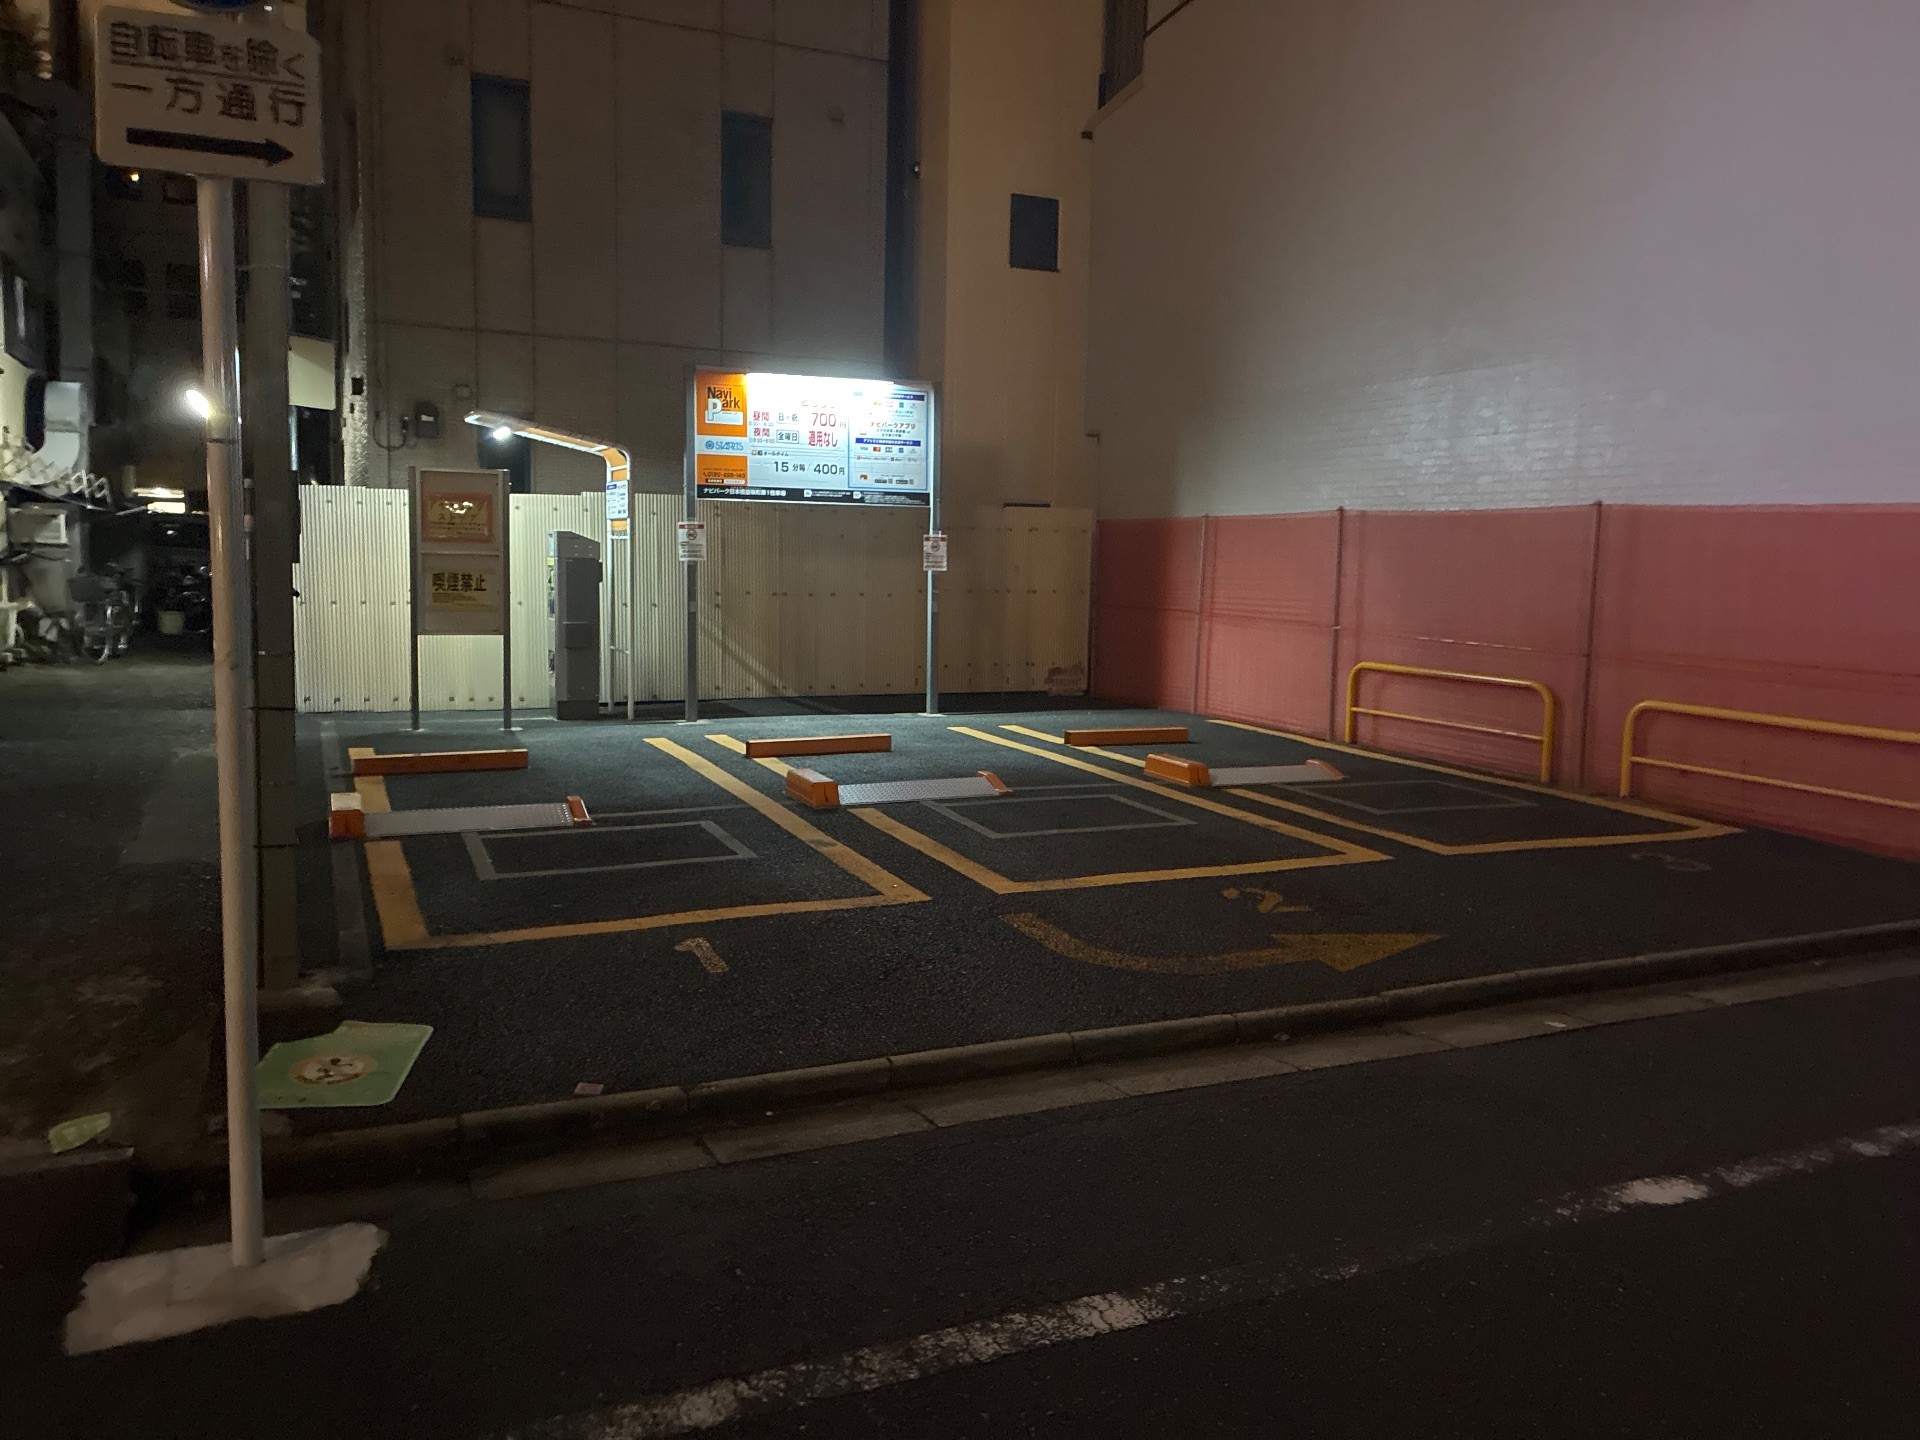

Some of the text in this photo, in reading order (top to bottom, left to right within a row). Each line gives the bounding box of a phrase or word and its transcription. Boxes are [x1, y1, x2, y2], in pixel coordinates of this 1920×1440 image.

[110, 20, 305, 80] 自転車を除く
[111, 77, 307, 127] 一方通行
[707, 386, 732, 400] Navi
[707, 397, 740, 422] Park
[752, 410, 770, 422] 昼間
[753, 427, 770, 437] 夜間
[777, 432, 798, 442] 金曜日
[808, 430, 838, 448] 適用なし
[432, 572, 487, 592] 喫煙禁止
[675, 936, 728, 973] 1
